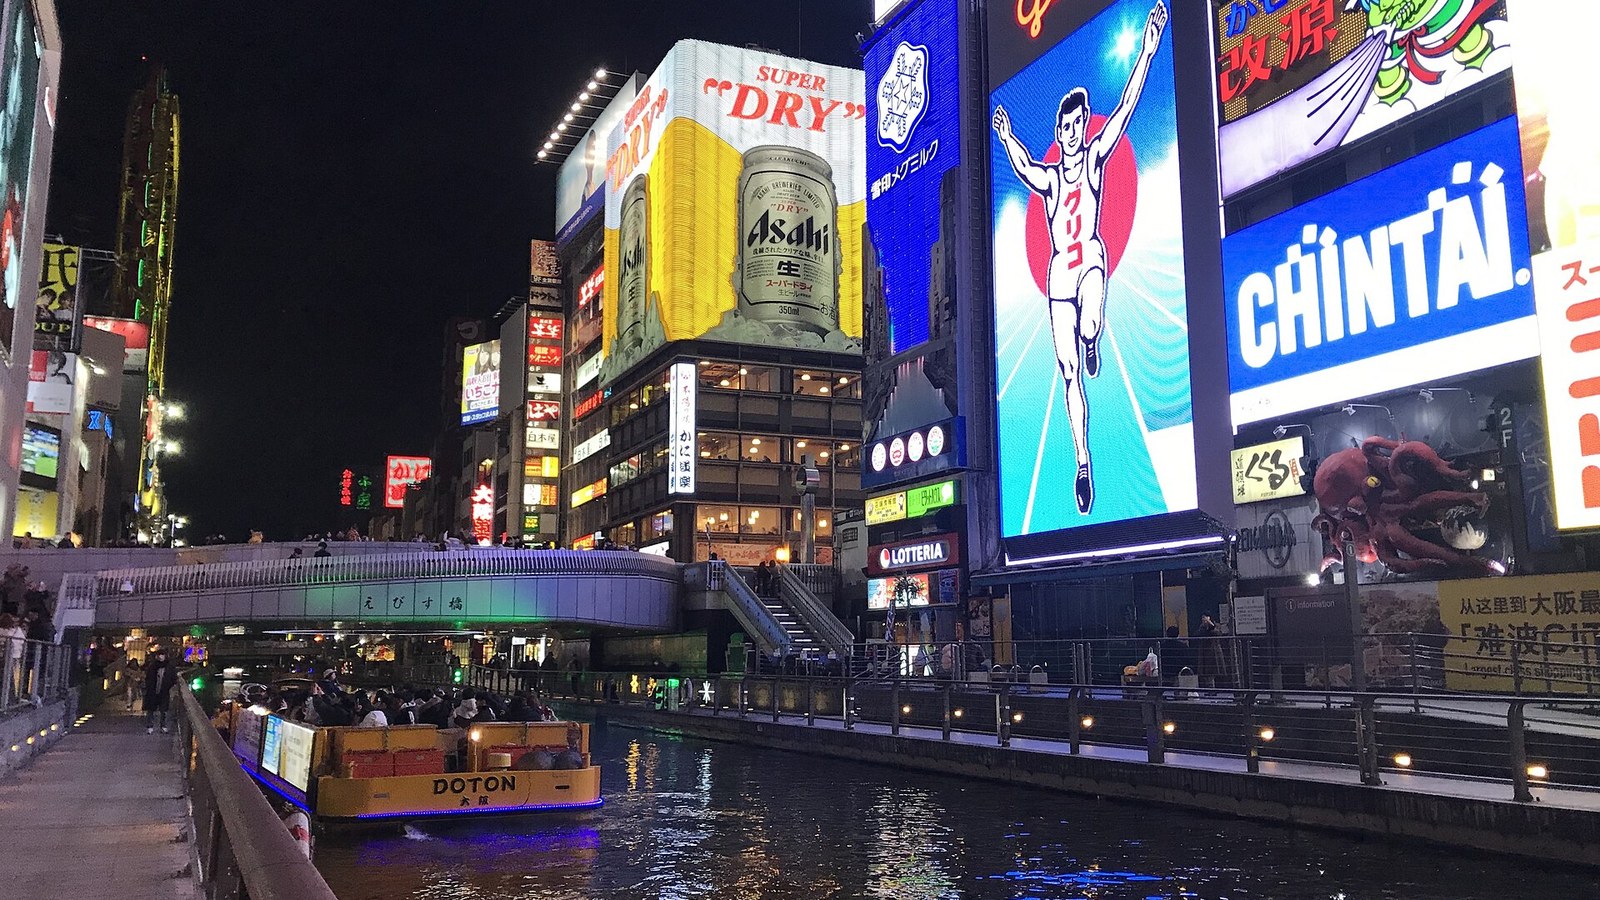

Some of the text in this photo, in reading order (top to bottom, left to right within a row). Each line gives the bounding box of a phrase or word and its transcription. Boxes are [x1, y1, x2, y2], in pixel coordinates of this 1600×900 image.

[1218, 0, 1338, 103] 改源
[756, 65, 827, 93] SUPER
[870, 139, 939, 201] 雪印メグミルク
[748, 209, 828, 256] Asahi
[1063, 184, 1083, 270] グリコ
[777, 260, 801, 278] 生
[766, 279, 812, 292] スーパードライ
[779, 305, 800, 316] 350ml
[1245, 449, 1290, 490] くくる
[892, 543, 943, 564] LOTTERIA
[364, 596, 463, 611] えびす橋
[433, 776, 516, 795] DOTON
